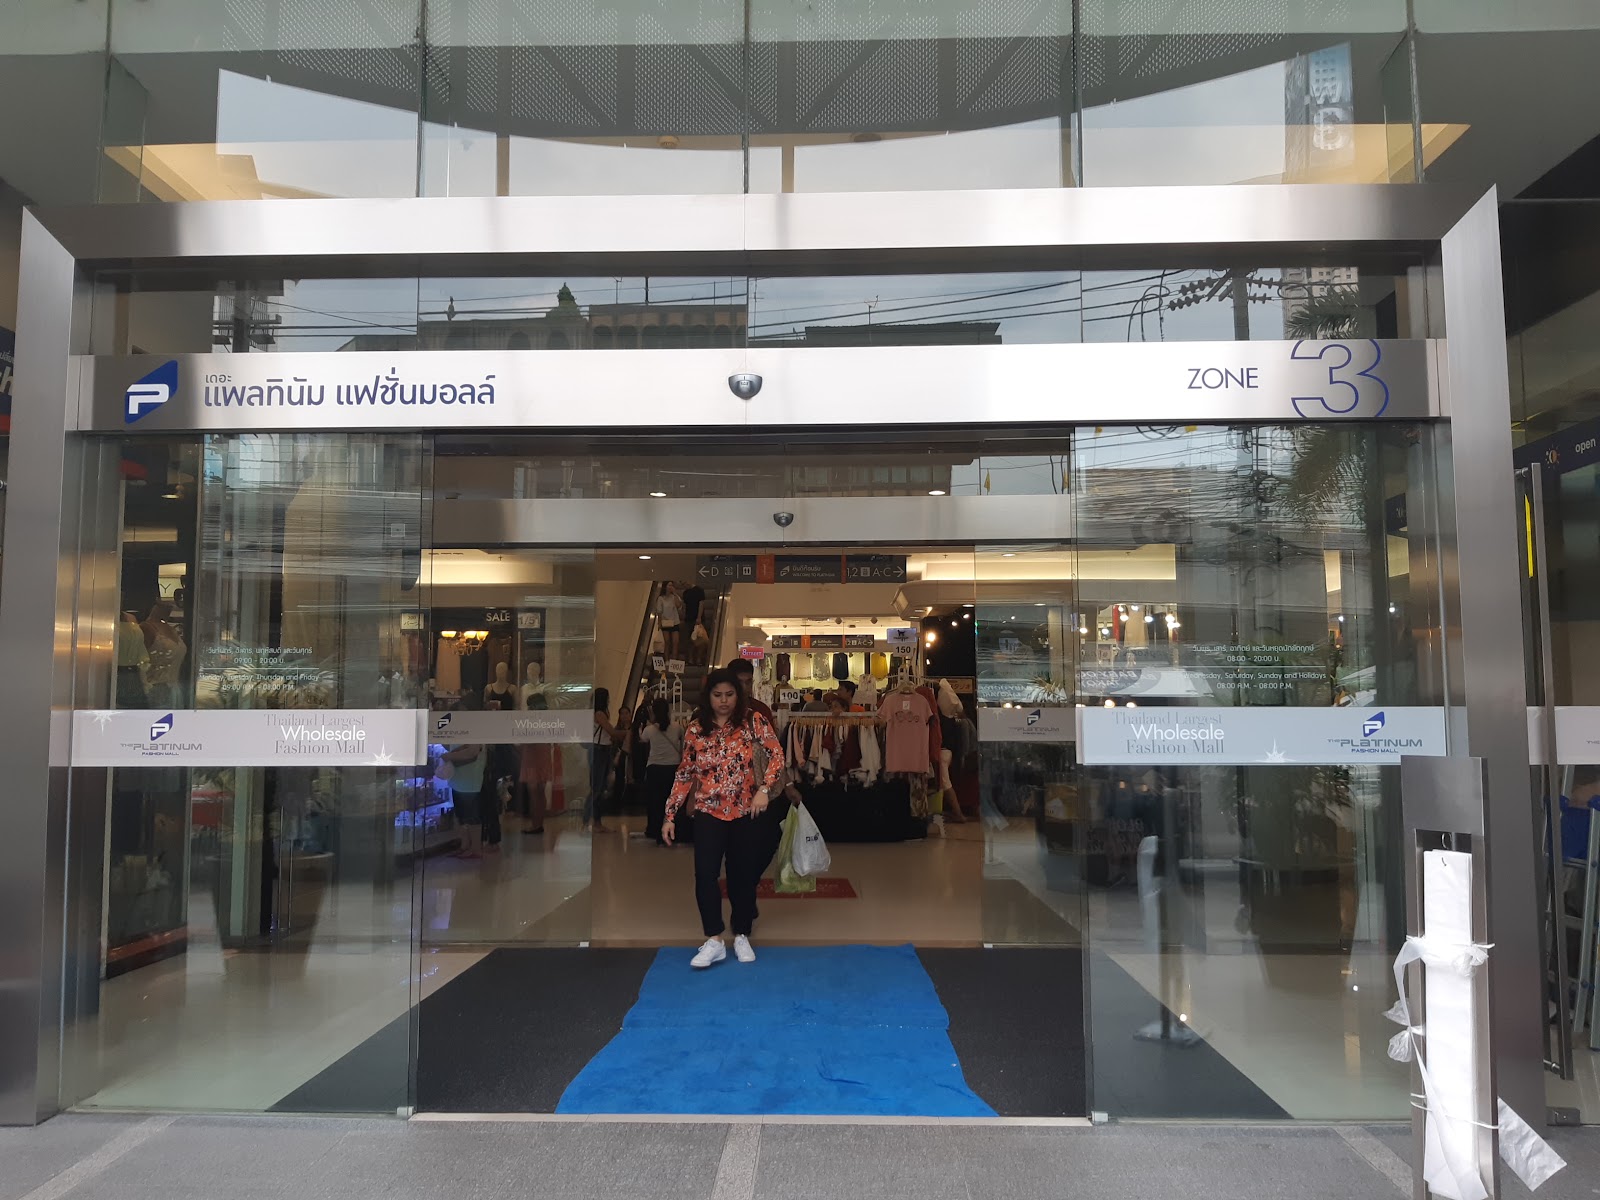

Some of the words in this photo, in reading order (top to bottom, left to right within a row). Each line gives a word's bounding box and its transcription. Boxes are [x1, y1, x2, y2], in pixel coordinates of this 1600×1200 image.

[205, 373, 232, 384] เดอะ
[1188, 367, 1259, 389] ZONE
[1290, 339, 1389, 418] 3
[204, 377, 325, 408] แพลทินัม
[336, 367, 496, 407] แฟชั่นมอลล์
[1575, 438, 1596, 454] open
[711, 568, 719, 577] D
[160, 583, 172, 594] Y
[486, 612, 511, 622] SALE
[895, 646, 911, 654] 150
[300, 673, 319, 681] Friday
[1225, 672, 1256, 681] Saturday,
[1257, 672, 1283, 681] Sunday
[1284, 672, 1297, 680] and
[1298, 672, 1327, 681] Holidays
[1237, 682, 1252, 690] A.M.
[1258, 682, 1278, 690] 08:00
[1279, 682, 1294, 690] P.M.
[781, 691, 799, 700] 100
[264, 713, 318, 727] Thailand
[319, 713, 366, 728] Largest
[1112, 711, 1173, 725] Thailand
[1175, 711, 1223, 727] Largest
[515, 720, 566, 730] Wholesale
[280, 725, 366, 742] Wholesale
[1131, 723, 1225, 741] Wholesale
[133, 743, 202, 751] PLATINUM
[275, 740, 331, 754] Fashion
[334, 740, 366, 754] Mall
[1126, 739, 1187, 754] Fashion
[1192, 739, 1225, 754] Mall
[1340, 738, 1423, 748] PLATINUM
